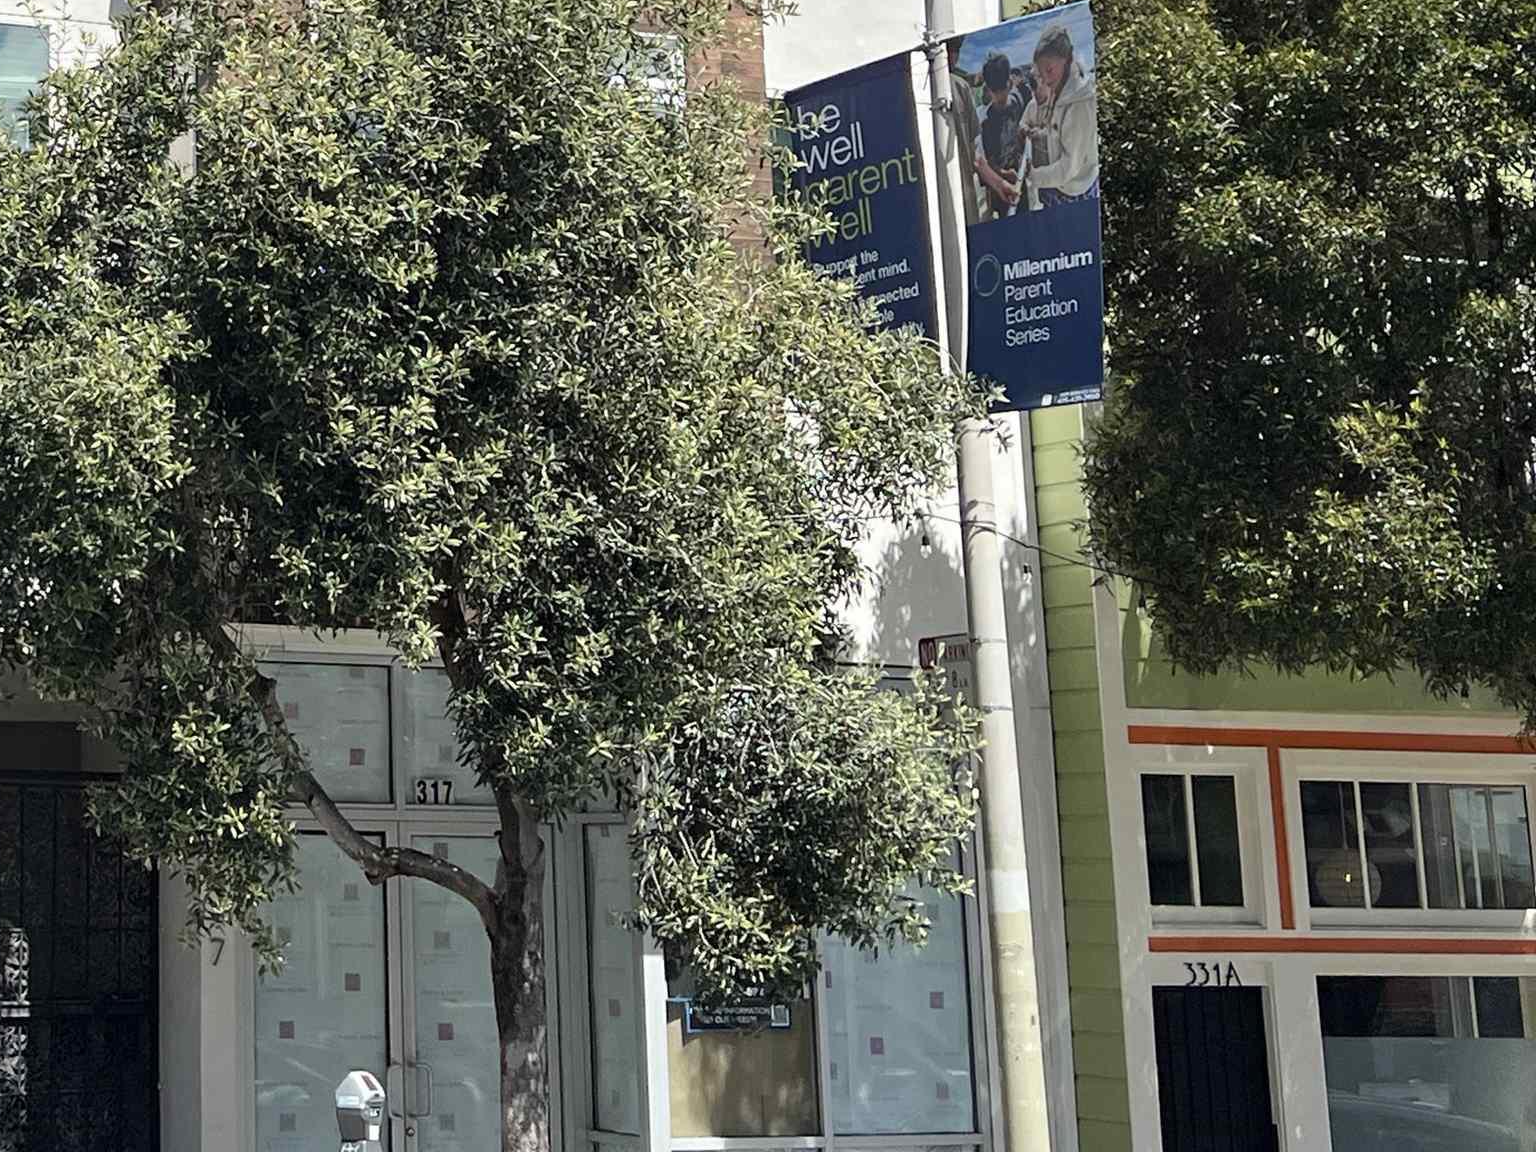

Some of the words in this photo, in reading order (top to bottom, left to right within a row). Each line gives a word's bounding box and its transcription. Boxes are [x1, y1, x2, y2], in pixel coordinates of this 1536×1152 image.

[796, 104, 841, 142] be
[800, 121, 865, 174] well
[860, 249, 879, 265] the
[877, 258, 912, 279] mind.
[1003, 250, 1094, 281] Millennium
[1004, 278, 1053, 303] Parent
[1005, 298, 1079, 325] Education
[1005, 326, 1051, 347] Series
[416, 779, 453, 805] 317
[1183, 960, 1243, 987] 331A
